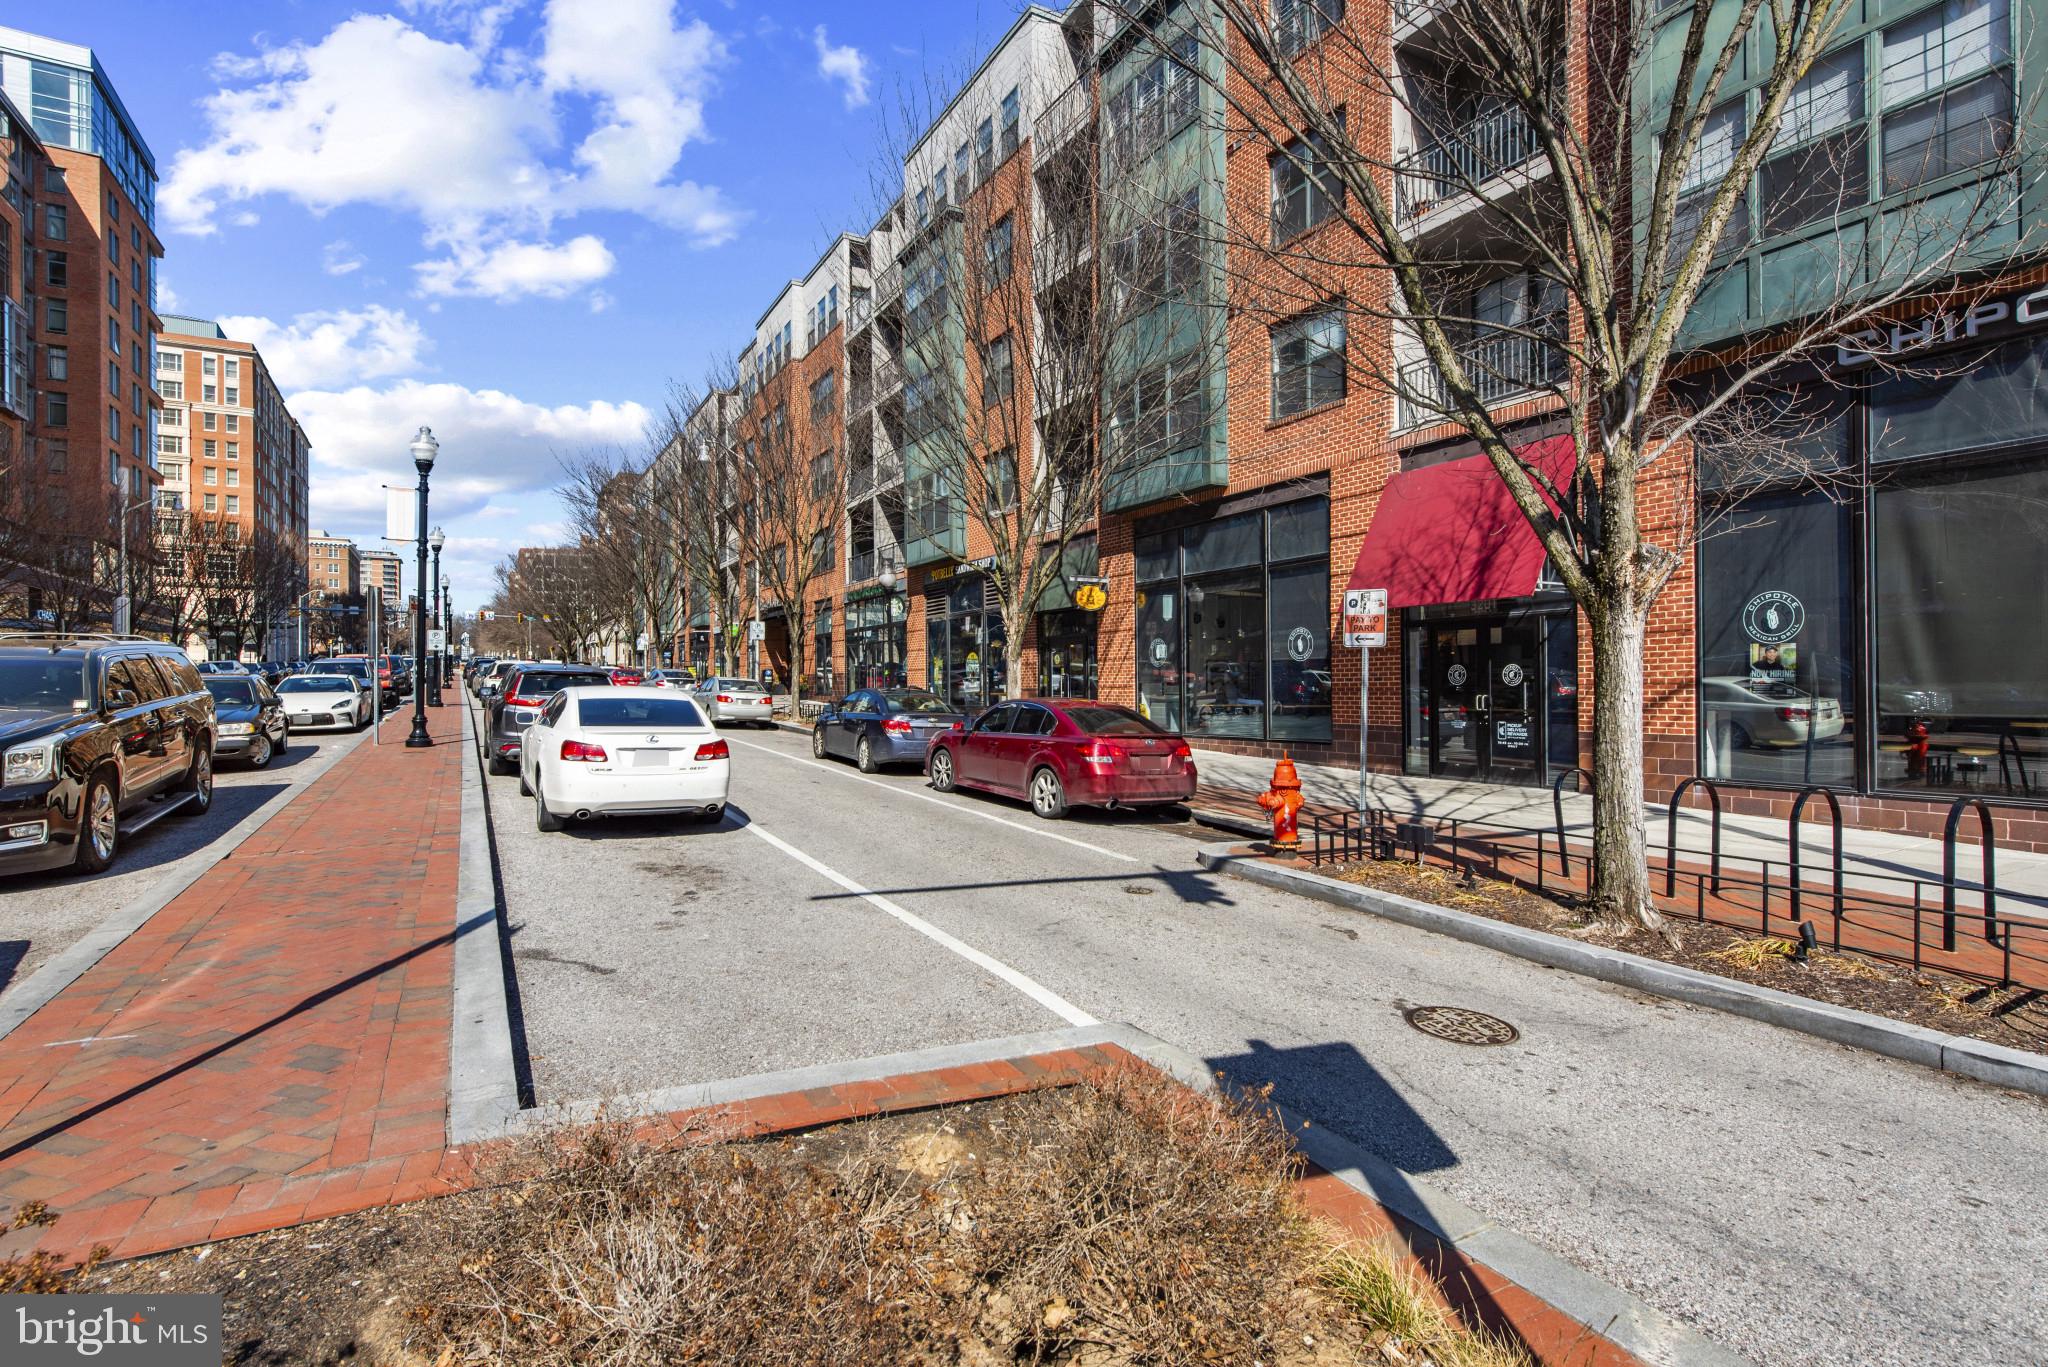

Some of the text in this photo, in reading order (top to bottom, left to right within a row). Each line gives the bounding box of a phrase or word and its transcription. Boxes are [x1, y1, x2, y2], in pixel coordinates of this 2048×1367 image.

[1748, 592, 1800, 611] CHIPOTLE
[1353, 624, 1377, 632] PARK
[1748, 623, 1800, 641] MEXICAN GRILL
[1751, 670, 1795, 678] NOW HIRING
